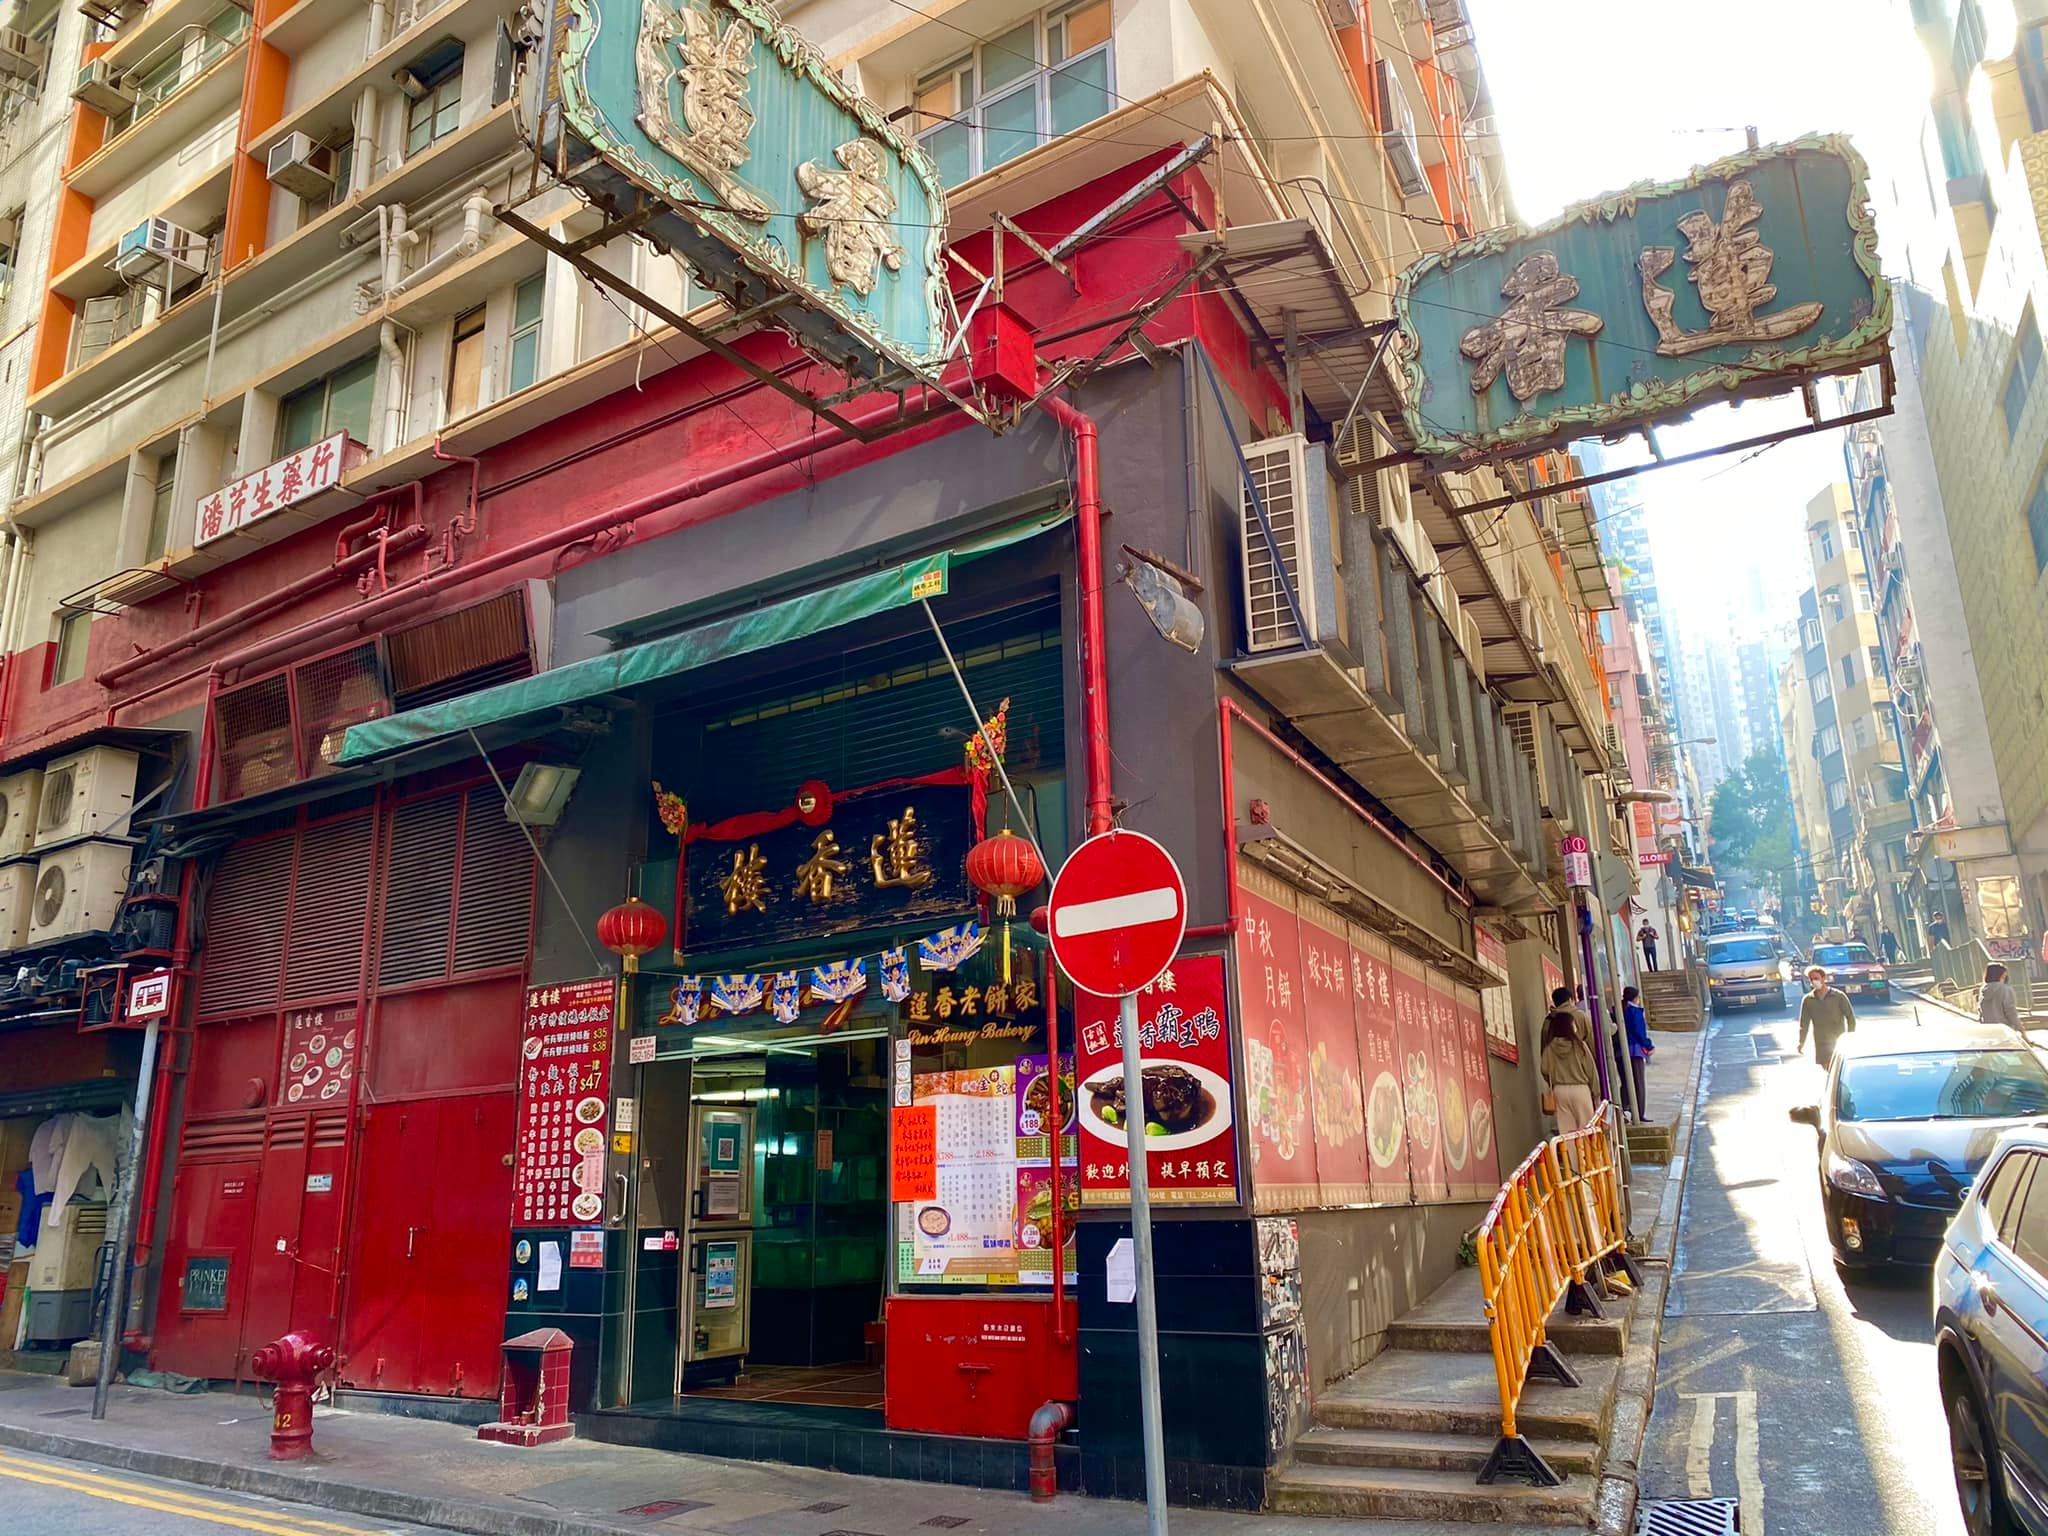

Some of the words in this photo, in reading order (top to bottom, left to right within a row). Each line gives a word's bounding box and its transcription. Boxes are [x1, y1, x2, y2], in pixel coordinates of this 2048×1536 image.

[1245, 907, 1275, 958] 中秋
[1264, 966, 1291, 1012] 月餅
[1307, 943, 1345, 1000] 嫁女餅
[909, 979, 1040, 1021] 蓮香老餅家
[931, 1025, 981, 1047] Heung
[981, 1021, 1039, 1042] Bakery
[580, 1072, 602, 1091] $47
[1086, 1161, 1131, 1181] 歡迎外
[1160, 1160, 1230, 1180] 提早預定
